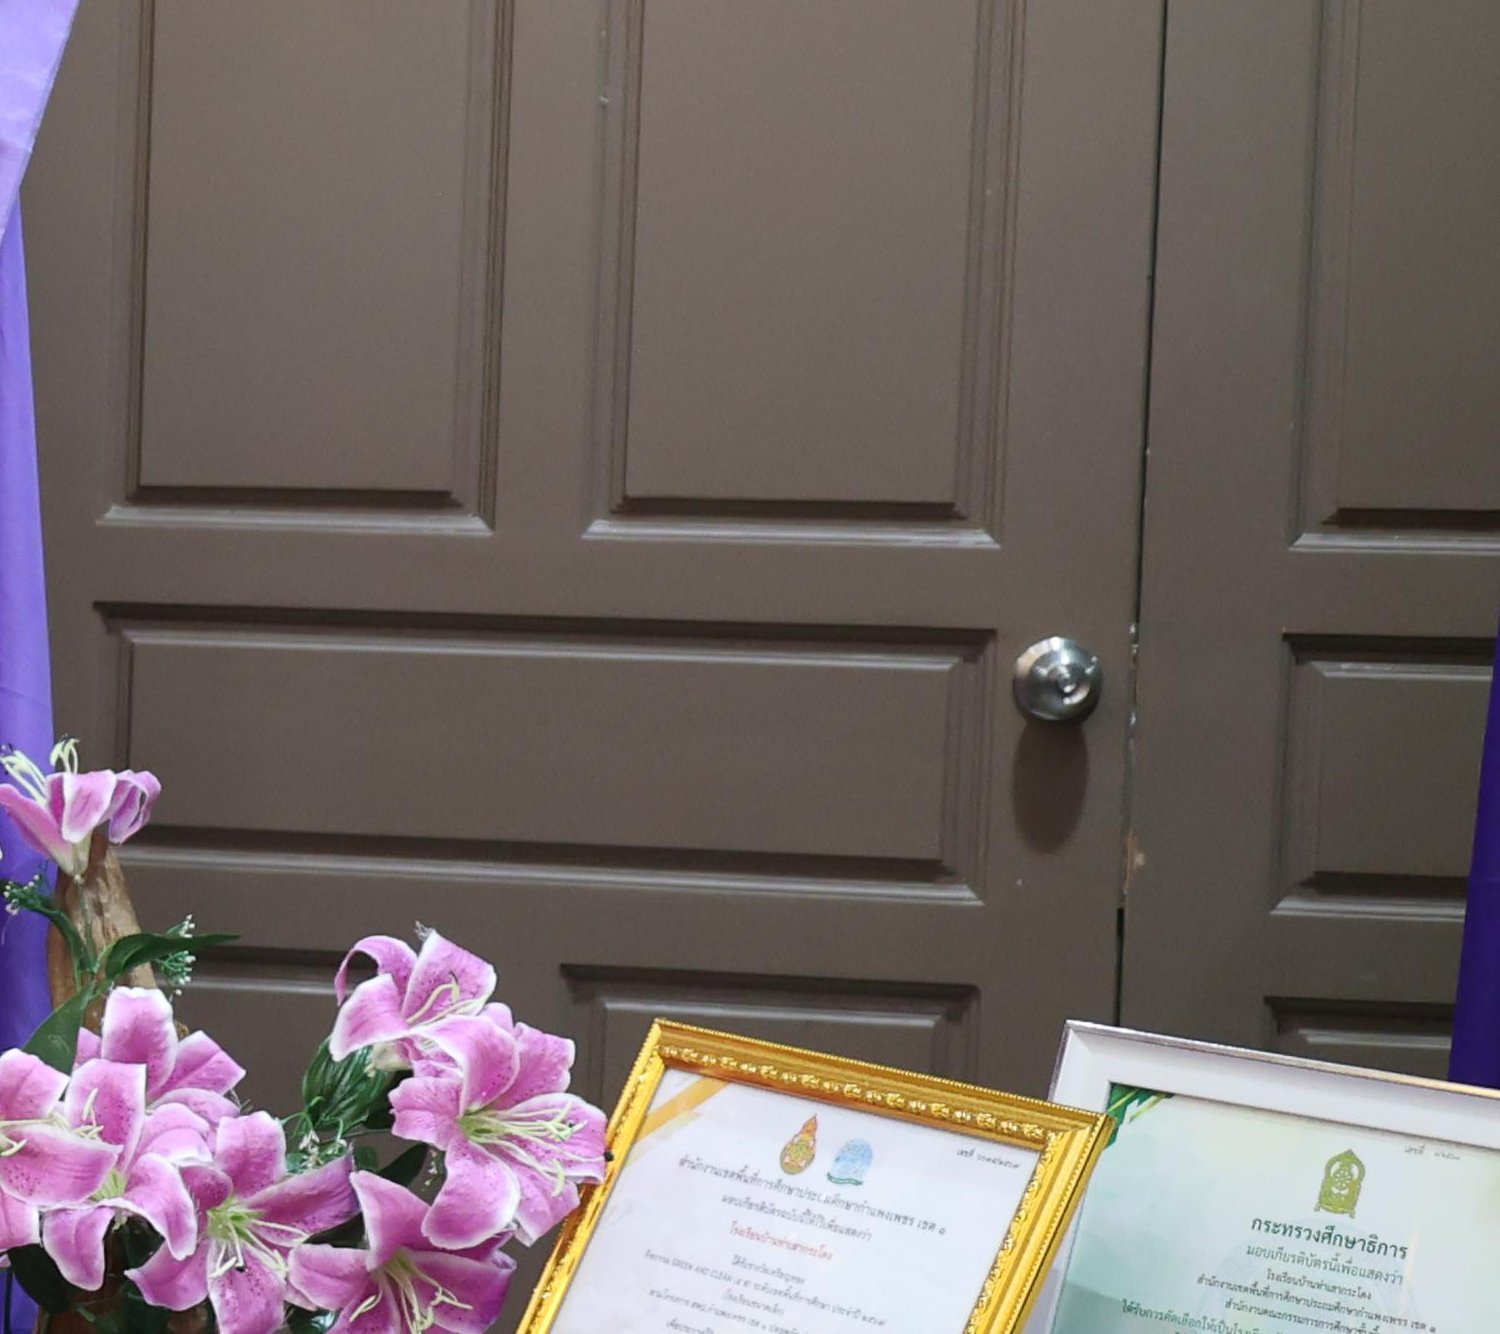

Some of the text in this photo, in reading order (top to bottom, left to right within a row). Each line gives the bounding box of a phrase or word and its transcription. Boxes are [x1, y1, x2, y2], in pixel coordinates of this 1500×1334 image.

[1250, 1217, 1409, 1261] กระทรวงศึกษาธิการ
